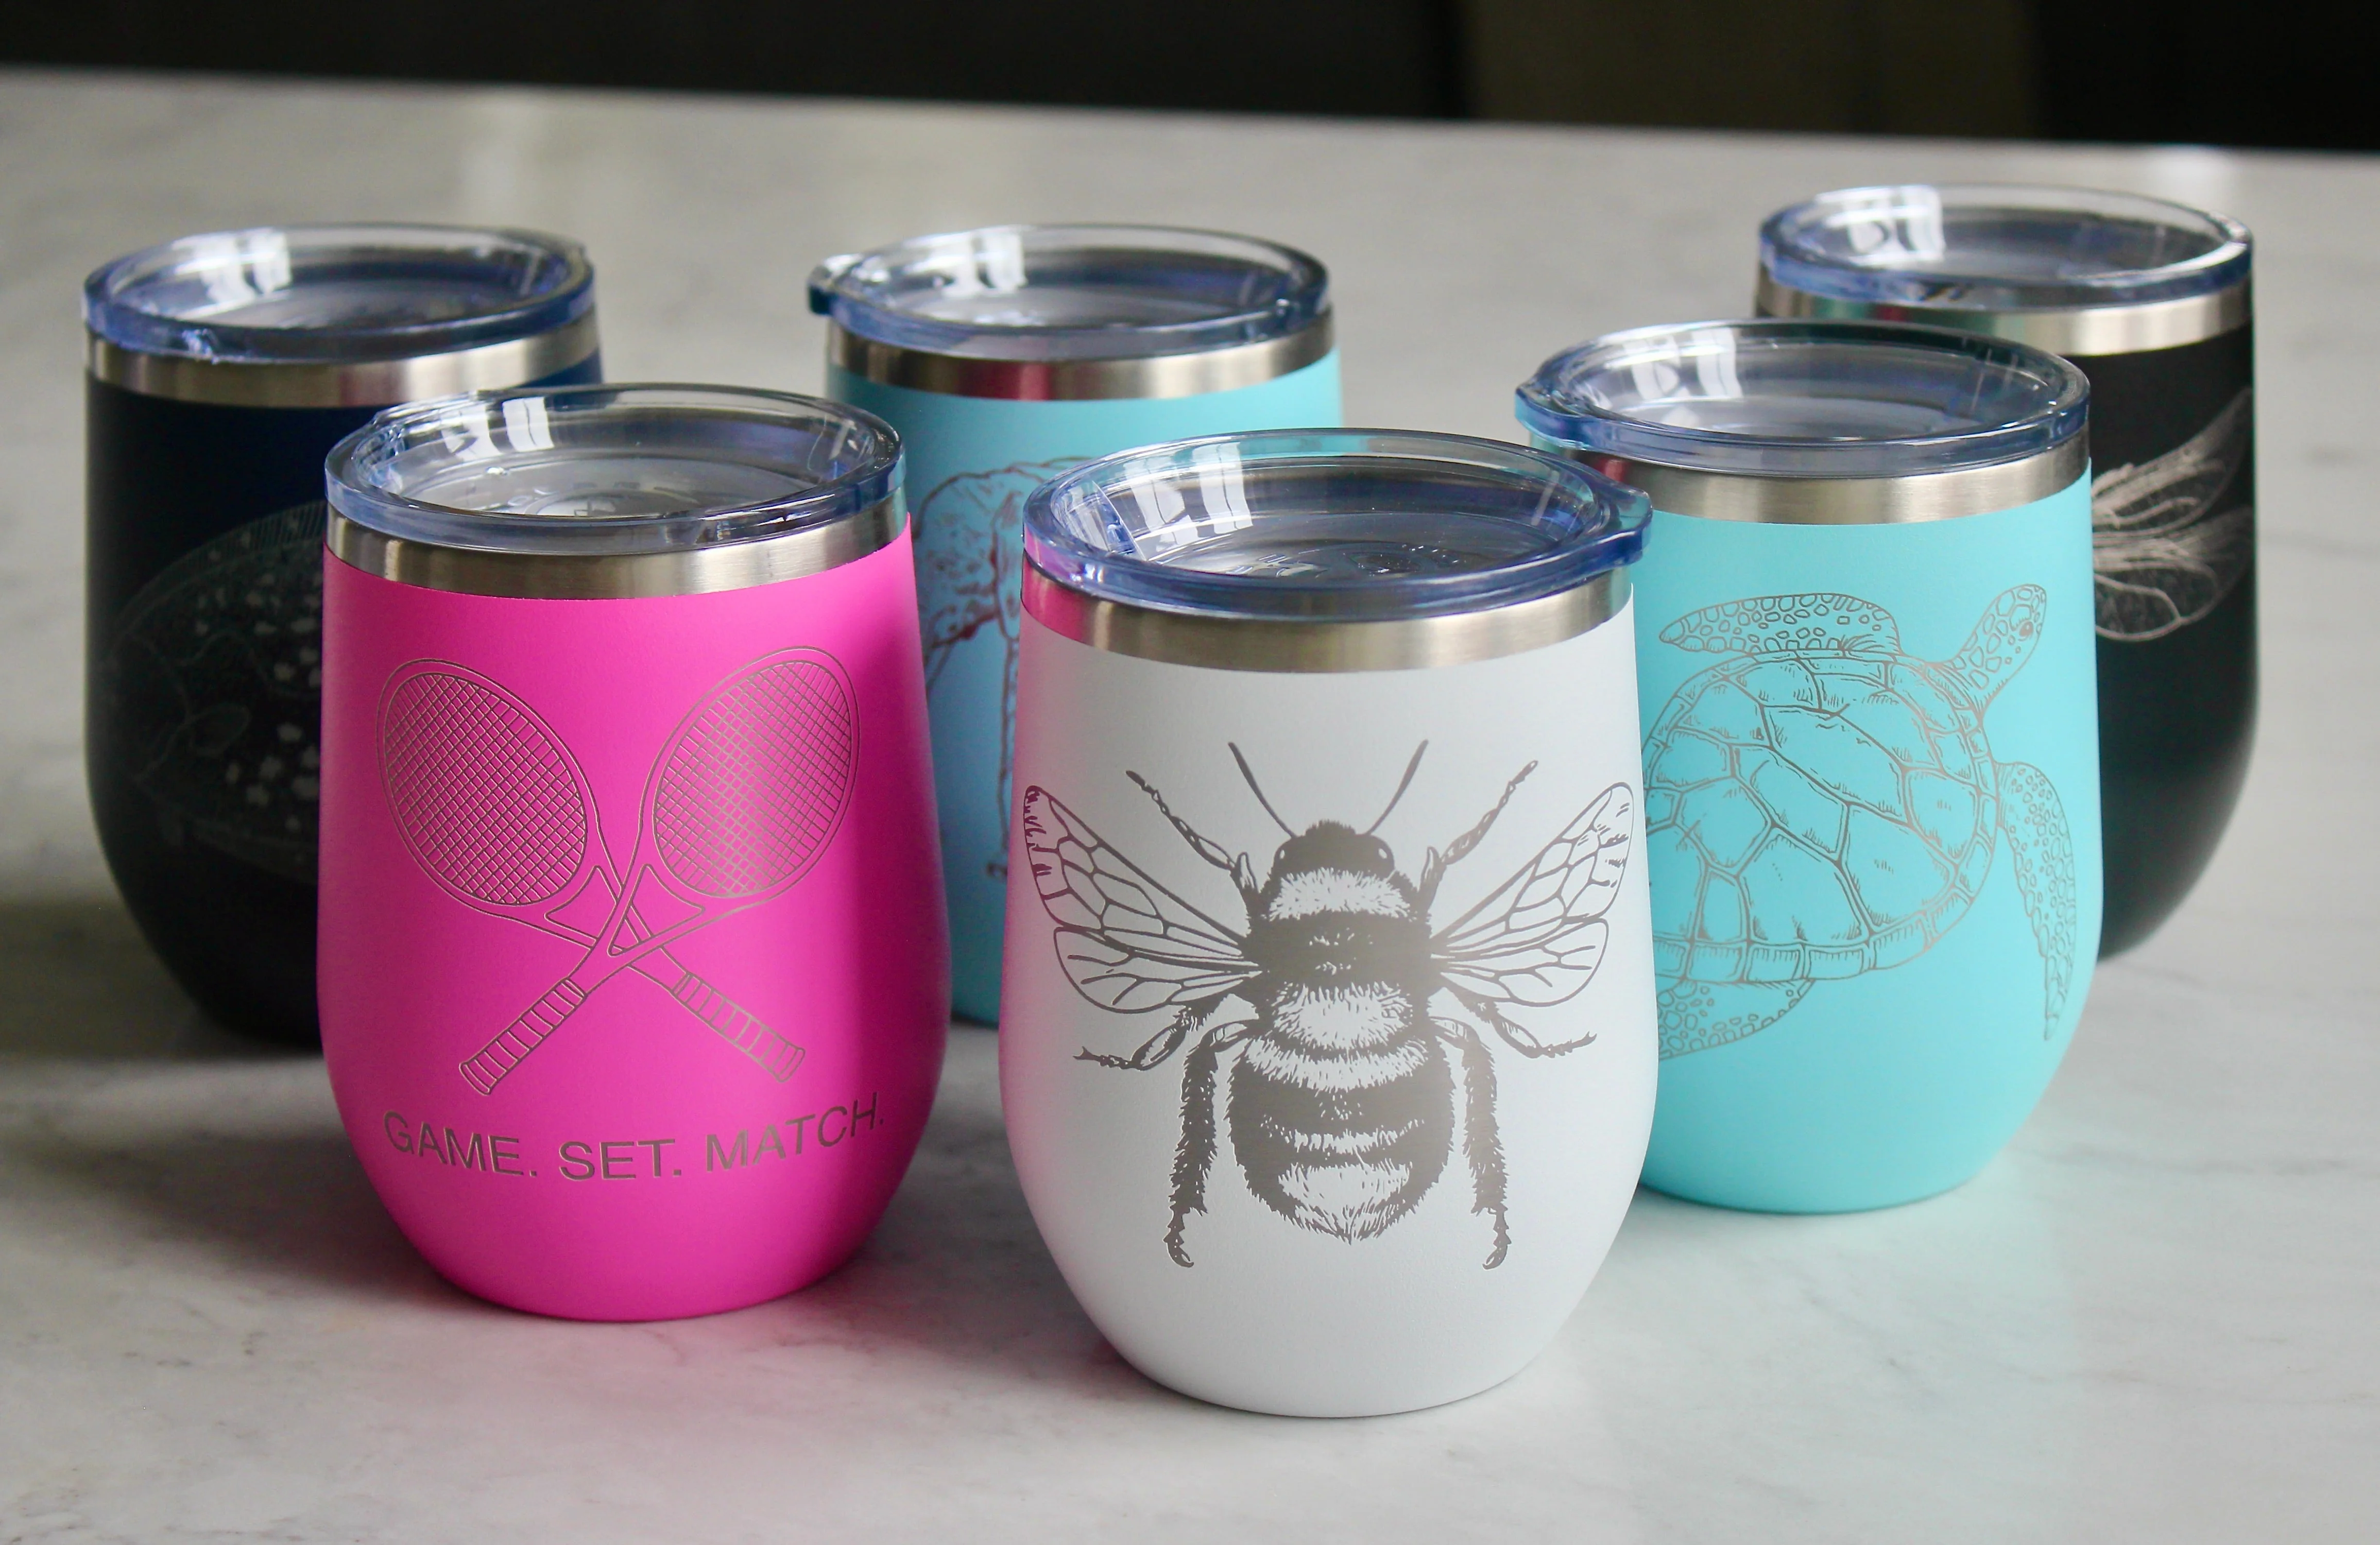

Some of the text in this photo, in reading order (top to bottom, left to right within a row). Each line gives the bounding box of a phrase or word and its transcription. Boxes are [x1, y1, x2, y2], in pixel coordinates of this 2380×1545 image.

[384, 1092, 884, 1181] GAME. SET. MATCH.
